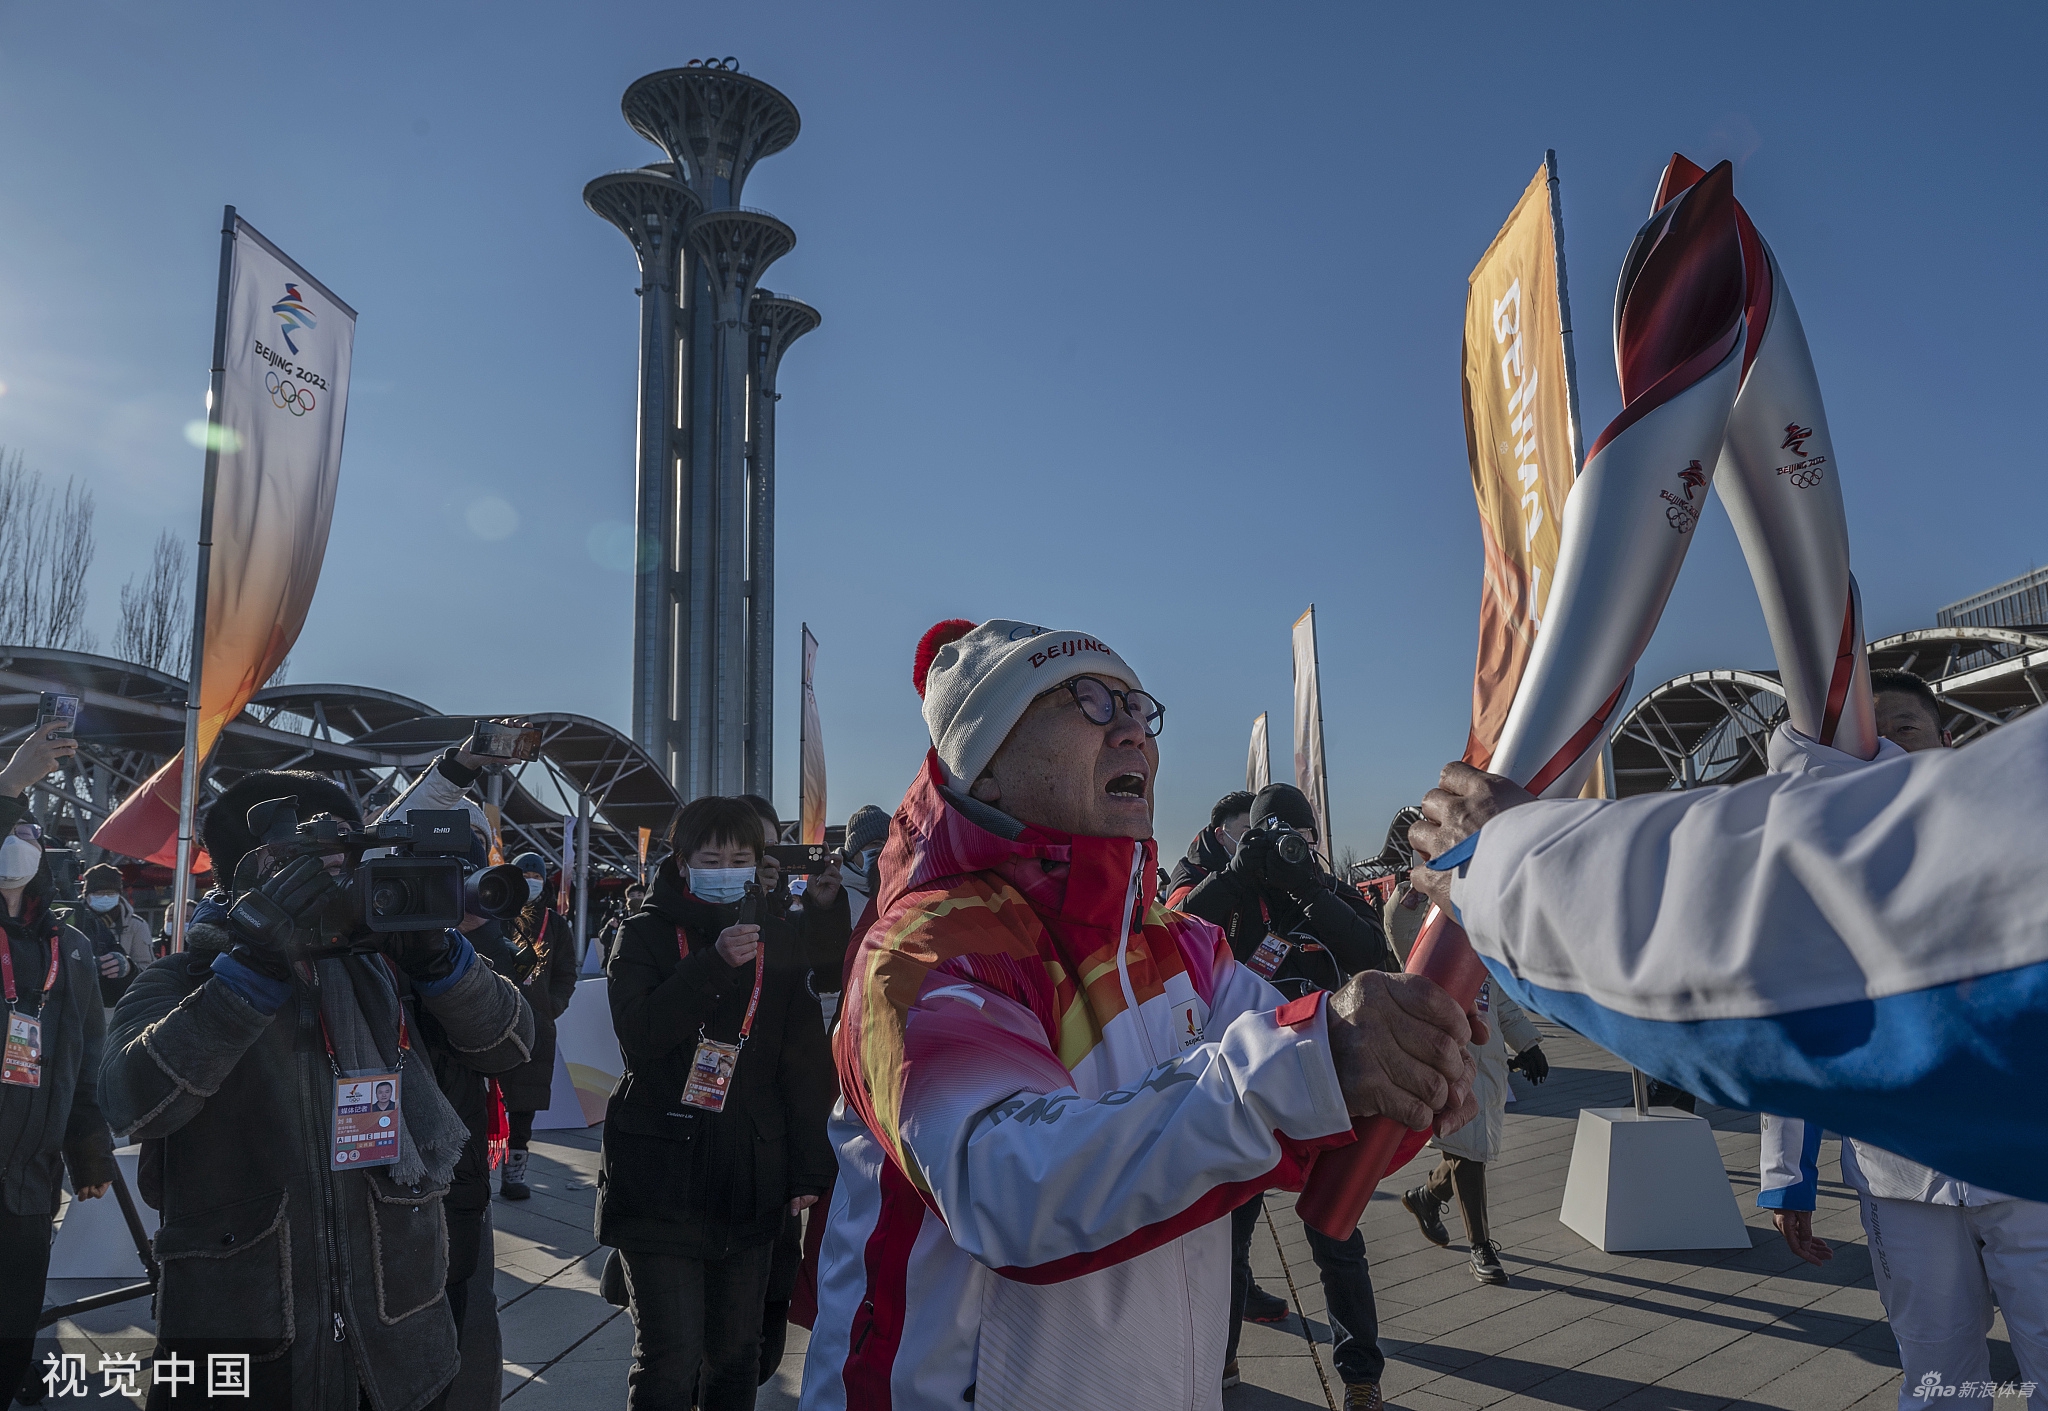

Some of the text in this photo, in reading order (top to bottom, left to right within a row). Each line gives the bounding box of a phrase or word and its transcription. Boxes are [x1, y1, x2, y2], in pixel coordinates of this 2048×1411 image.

[254, 339, 328, 392] BEIJING 2022
[1775, 459, 1807, 476] BEIJING
[1659, 489, 1688, 511] BEIJING
[1027, 638, 1111, 669] BEIJING
[236, 906, 262, 929] Panasonic
[1229, 911, 1240, 938] Canon
[1870, 1201, 1892, 1281] BEIJING 2022
